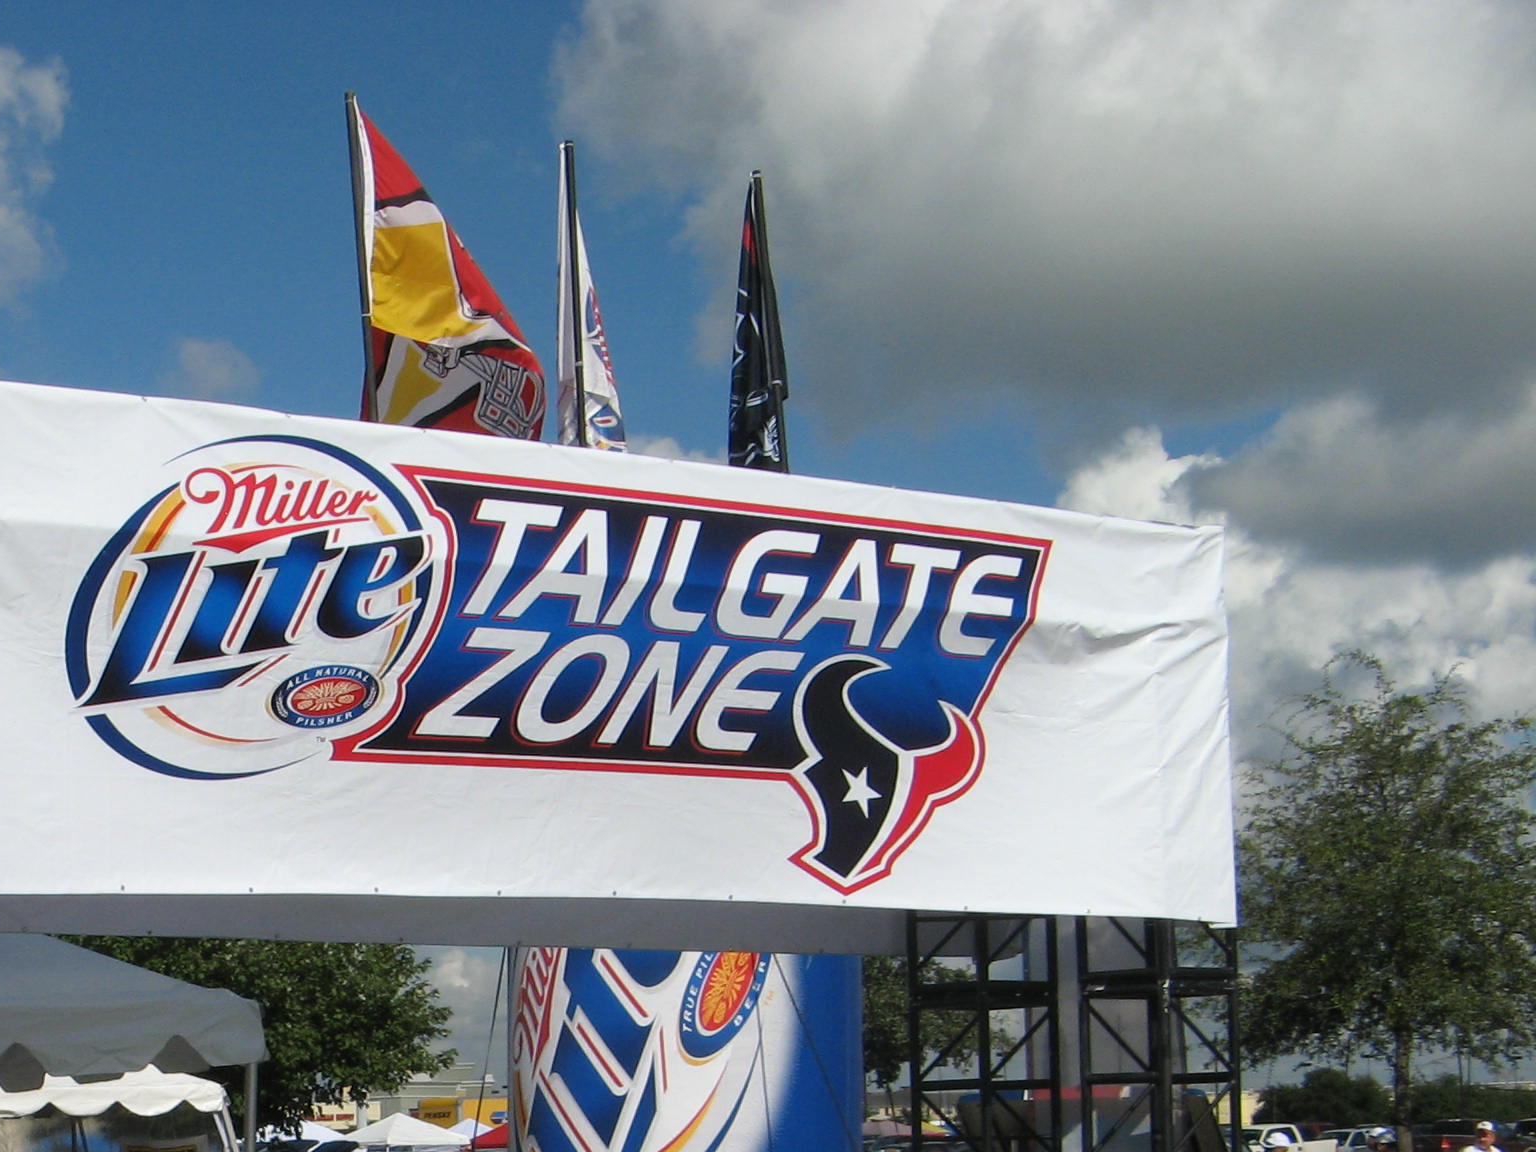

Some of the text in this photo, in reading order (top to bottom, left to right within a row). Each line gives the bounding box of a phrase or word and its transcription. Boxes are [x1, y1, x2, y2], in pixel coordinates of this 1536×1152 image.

[185, 466, 378, 534] Miller
[465, 498, 1026, 658] TAILGATE
[82, 530, 426, 706] Lite
[286, 666, 370, 690] ALL NATURAL
[414, 627, 806, 754] ZONE
[295, 711, 353, 726] PILSNER
[683, 985, 699, 1033] TRUE
[732, 961, 767, 1027] BEER
